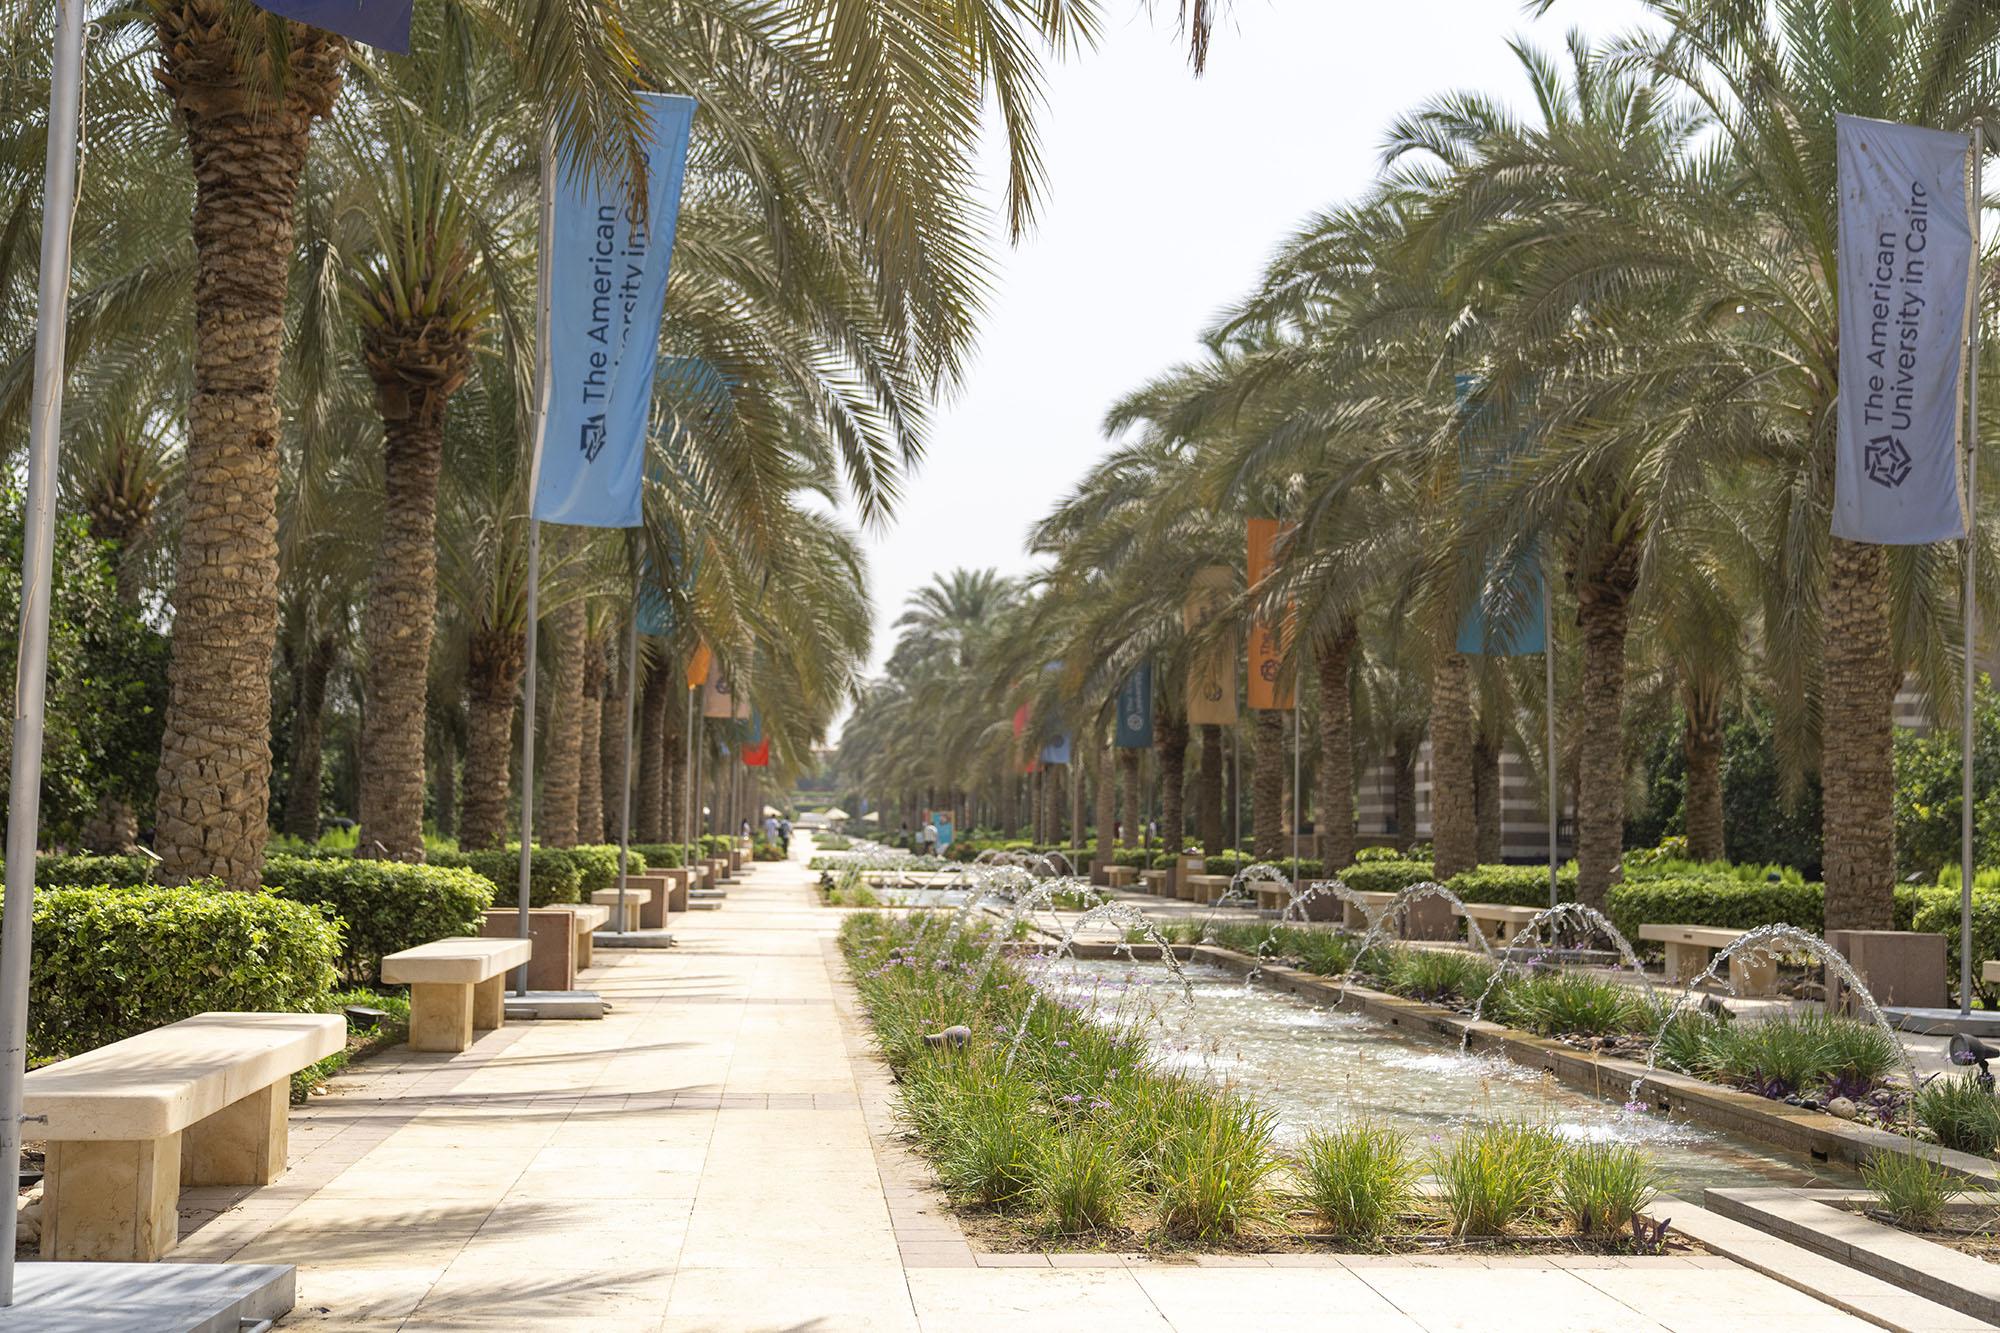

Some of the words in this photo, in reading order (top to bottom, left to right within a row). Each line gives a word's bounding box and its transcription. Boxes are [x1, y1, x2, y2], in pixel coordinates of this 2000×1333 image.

[587, 206, 615, 345] American
[1866, 232, 1896, 369] American
[1899, 260, 1924, 285] in
[583, 352, 607, 404] The
[1864, 375, 1885, 425] The
[1890, 292, 1926, 431] University
